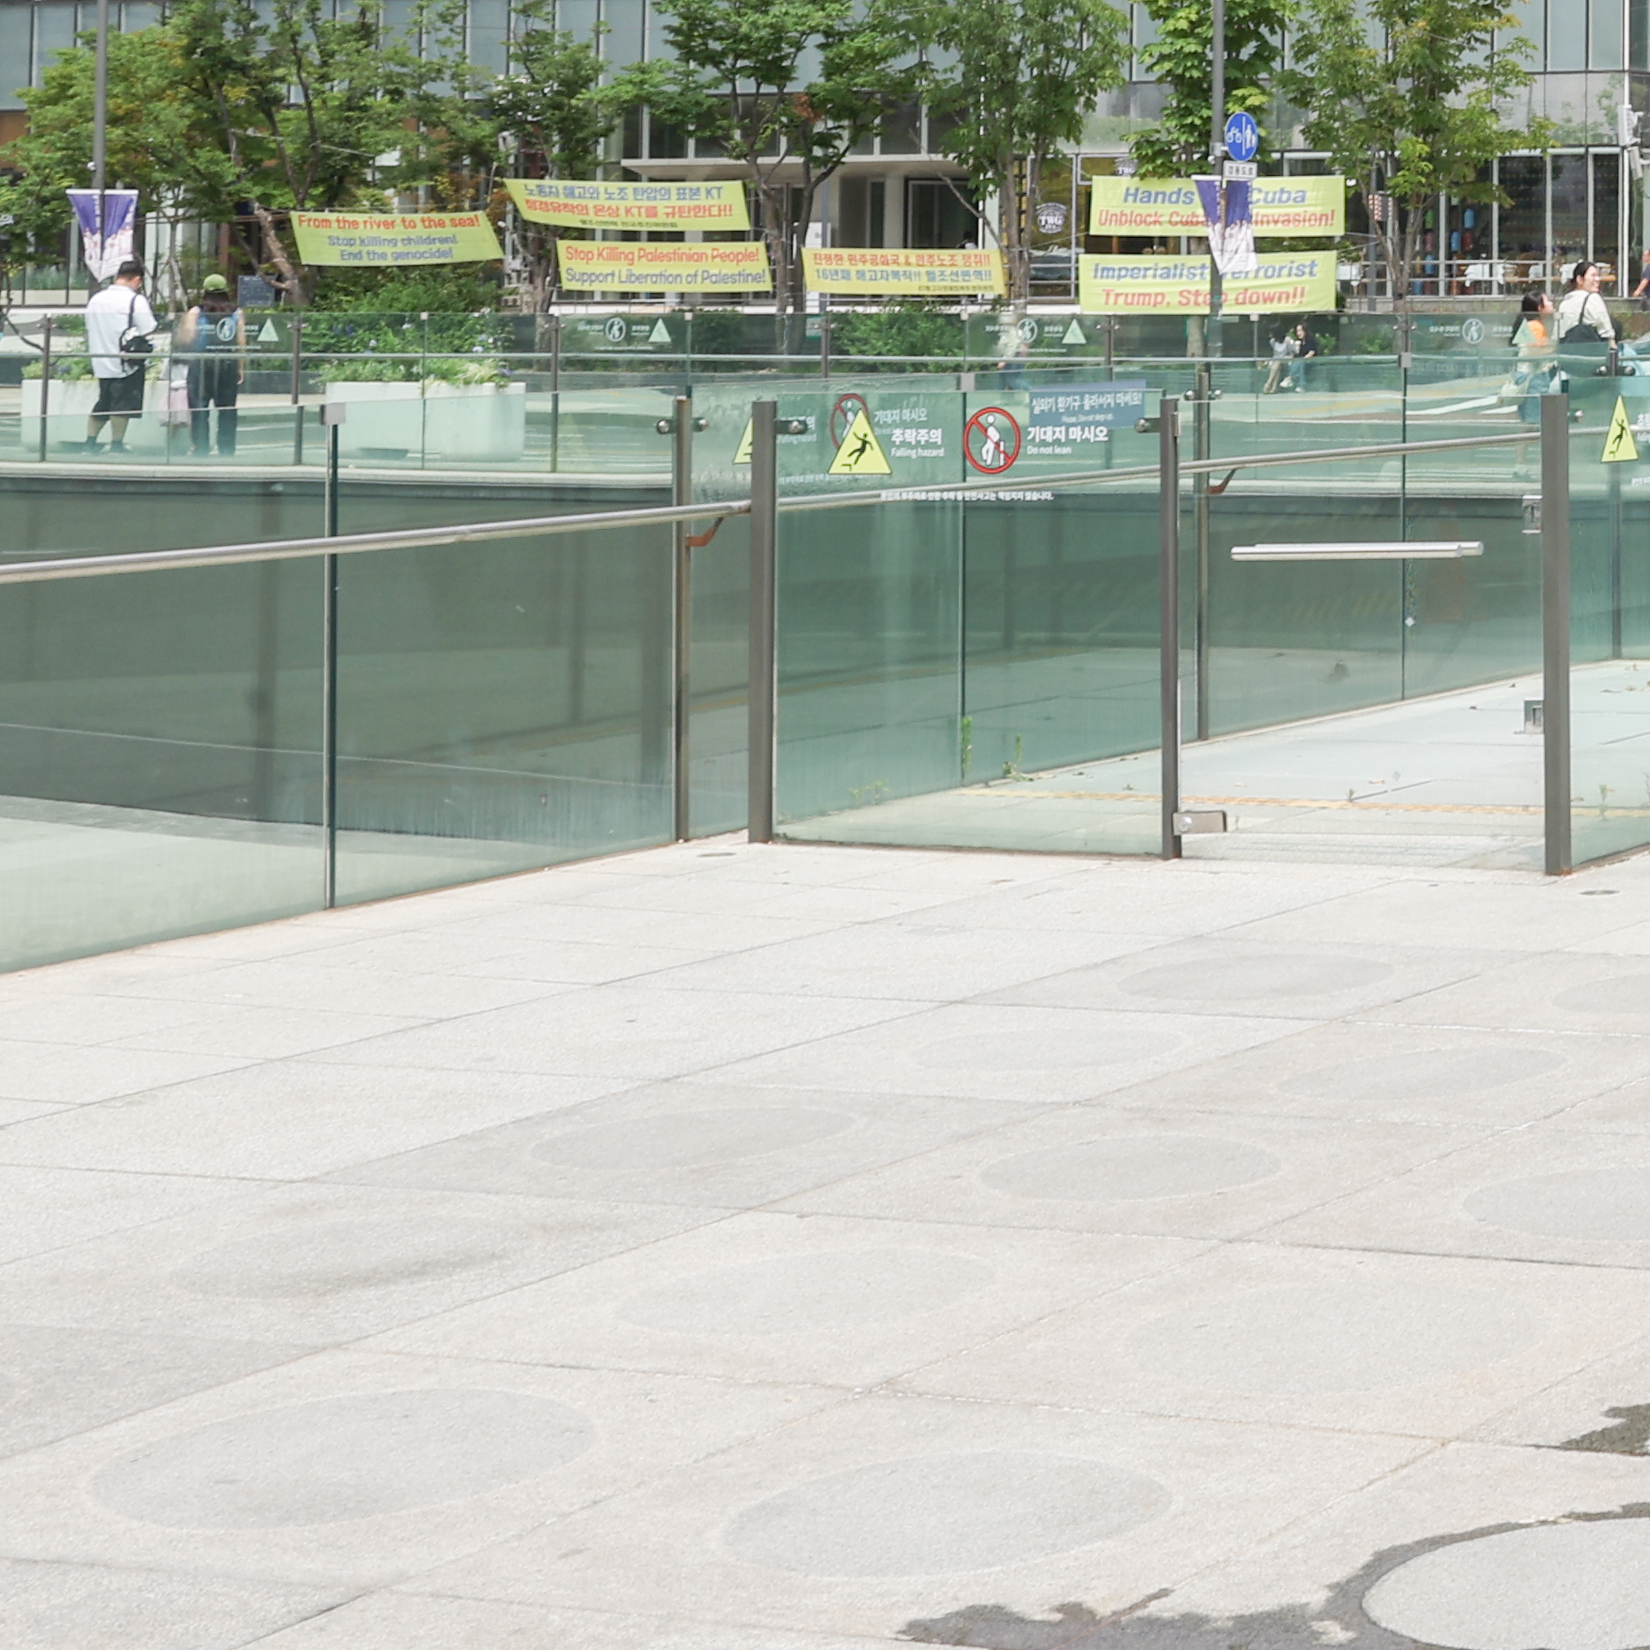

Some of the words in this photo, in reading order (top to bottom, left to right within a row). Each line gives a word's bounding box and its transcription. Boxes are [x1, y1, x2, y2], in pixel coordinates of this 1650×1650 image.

[604, 186, 628, 200] 노조
[706, 186, 723, 199] KT
[1123, 187, 1195, 205] Hands
[1250, 188, 1307, 205] Cuba
[298, 215, 331, 229] From
[336, 216, 359, 229] the
[363, 216, 396, 229] river
[402, 217, 416, 229] to
[422, 216, 445, 229] the
[450, 215, 480, 228] sea!
[1099, 209, 1162, 227] Unblock
[1256, 209, 1336, 227] Invasion!
[328, 235, 357, 248] Stop
[359, 235, 398, 248] killing
[401, 234, 458, 246] children!
[341, 250, 363, 261] End
[367, 249, 387, 261] the
[391, 248, 453, 262] genocide!
[565, 246, 594, 264] Stop
[596, 246, 634, 265] Killing
[637, 247, 708, 263] Palestinian
[711, 247, 760, 265] People!
[565, 268, 615, 286] Support
[618, 268, 683, 285] Liberation
[685, 270, 700, 284] of
[701, 269, 766, 284] Palestine!
[1093, 262, 1210, 281] Imperialist
[1102, 288, 1170, 308] Trump,
[1235, 286, 1306, 306] down!!
[891, 428, 942, 445] 추락주의
[1027, 425, 1066, 443] 기대지
[1068, 425, 1108, 443] 마시오
[891, 447, 918, 459] Falling
[918, 447, 944, 457] hazard
[1027, 446, 1038, 454] Do
[1039, 446, 1052, 454] not
[1054, 446, 1072, 454] lean
